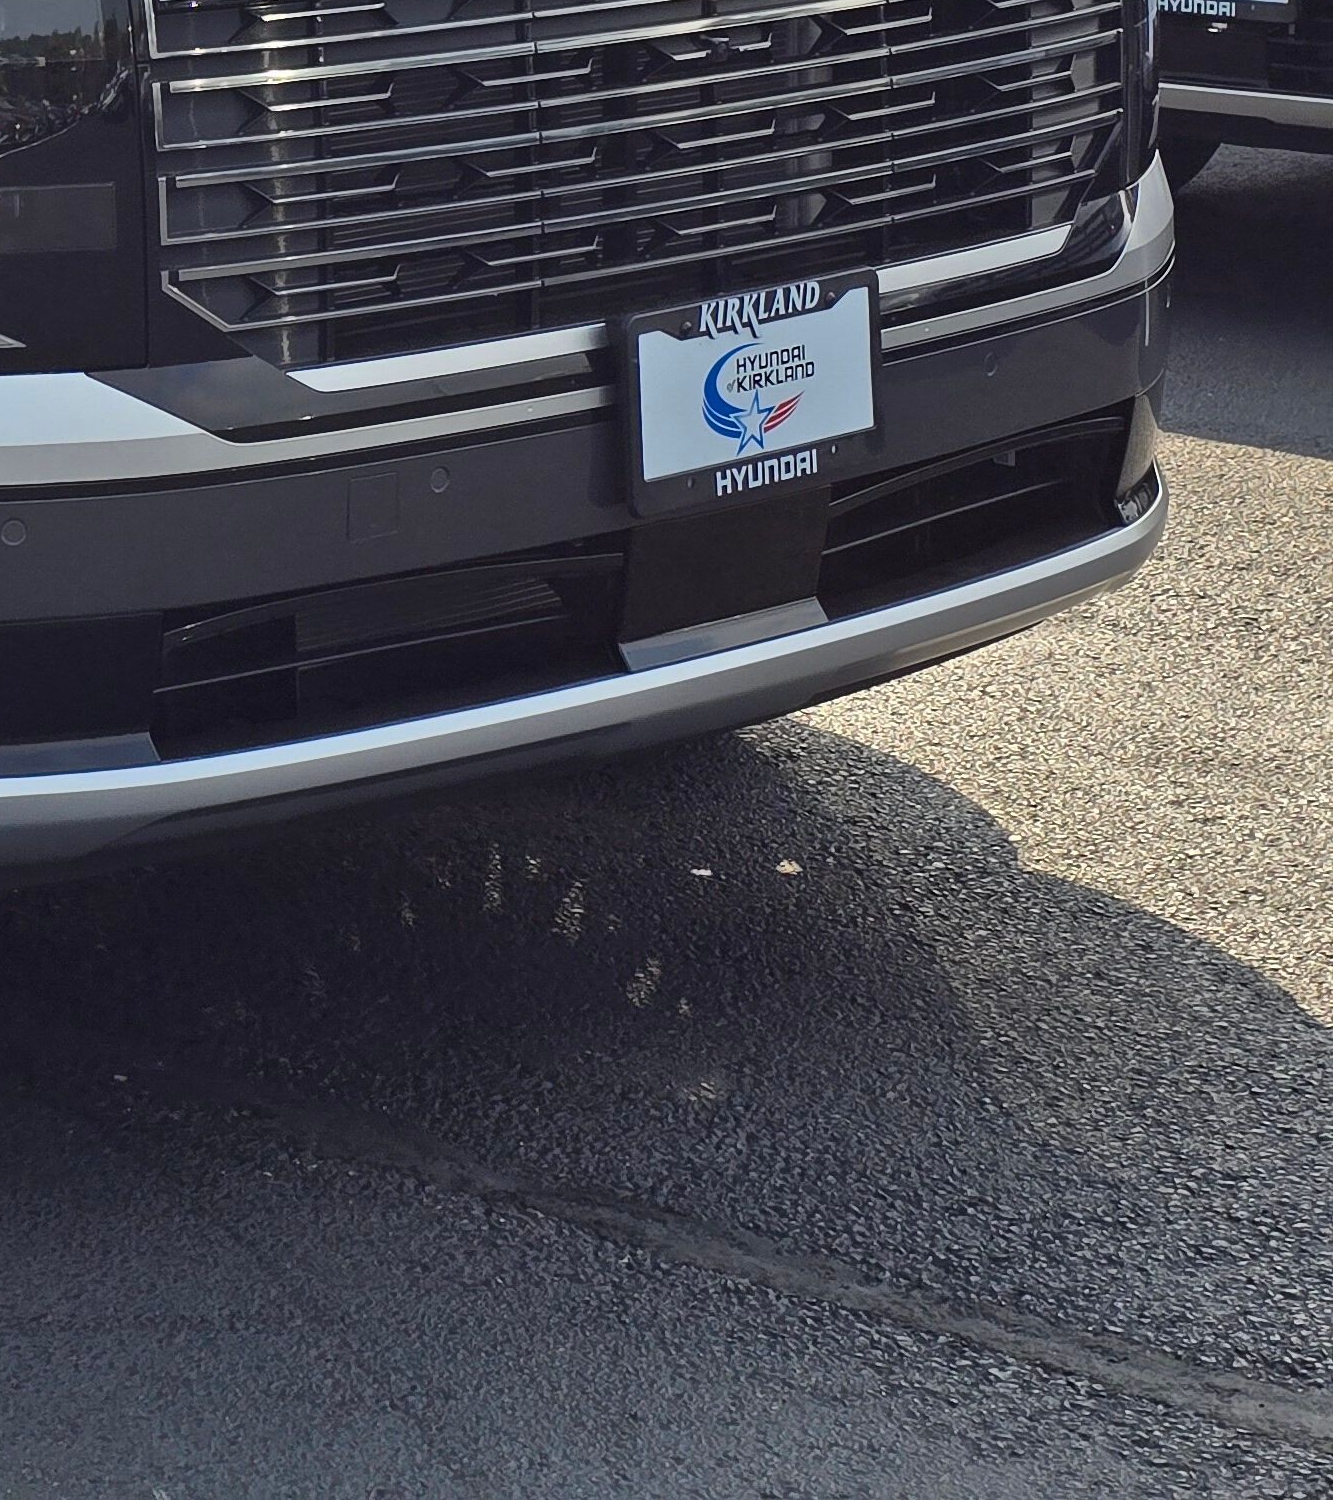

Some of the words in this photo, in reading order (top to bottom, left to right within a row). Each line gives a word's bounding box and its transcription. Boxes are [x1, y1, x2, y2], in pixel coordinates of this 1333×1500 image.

[699, 281, 821, 339] KIRKLAND
[736, 345, 806, 375] HYUNDAI
[736, 361, 816, 393] KIRKLAND
[715, 449, 819, 497] HYUNDAI
